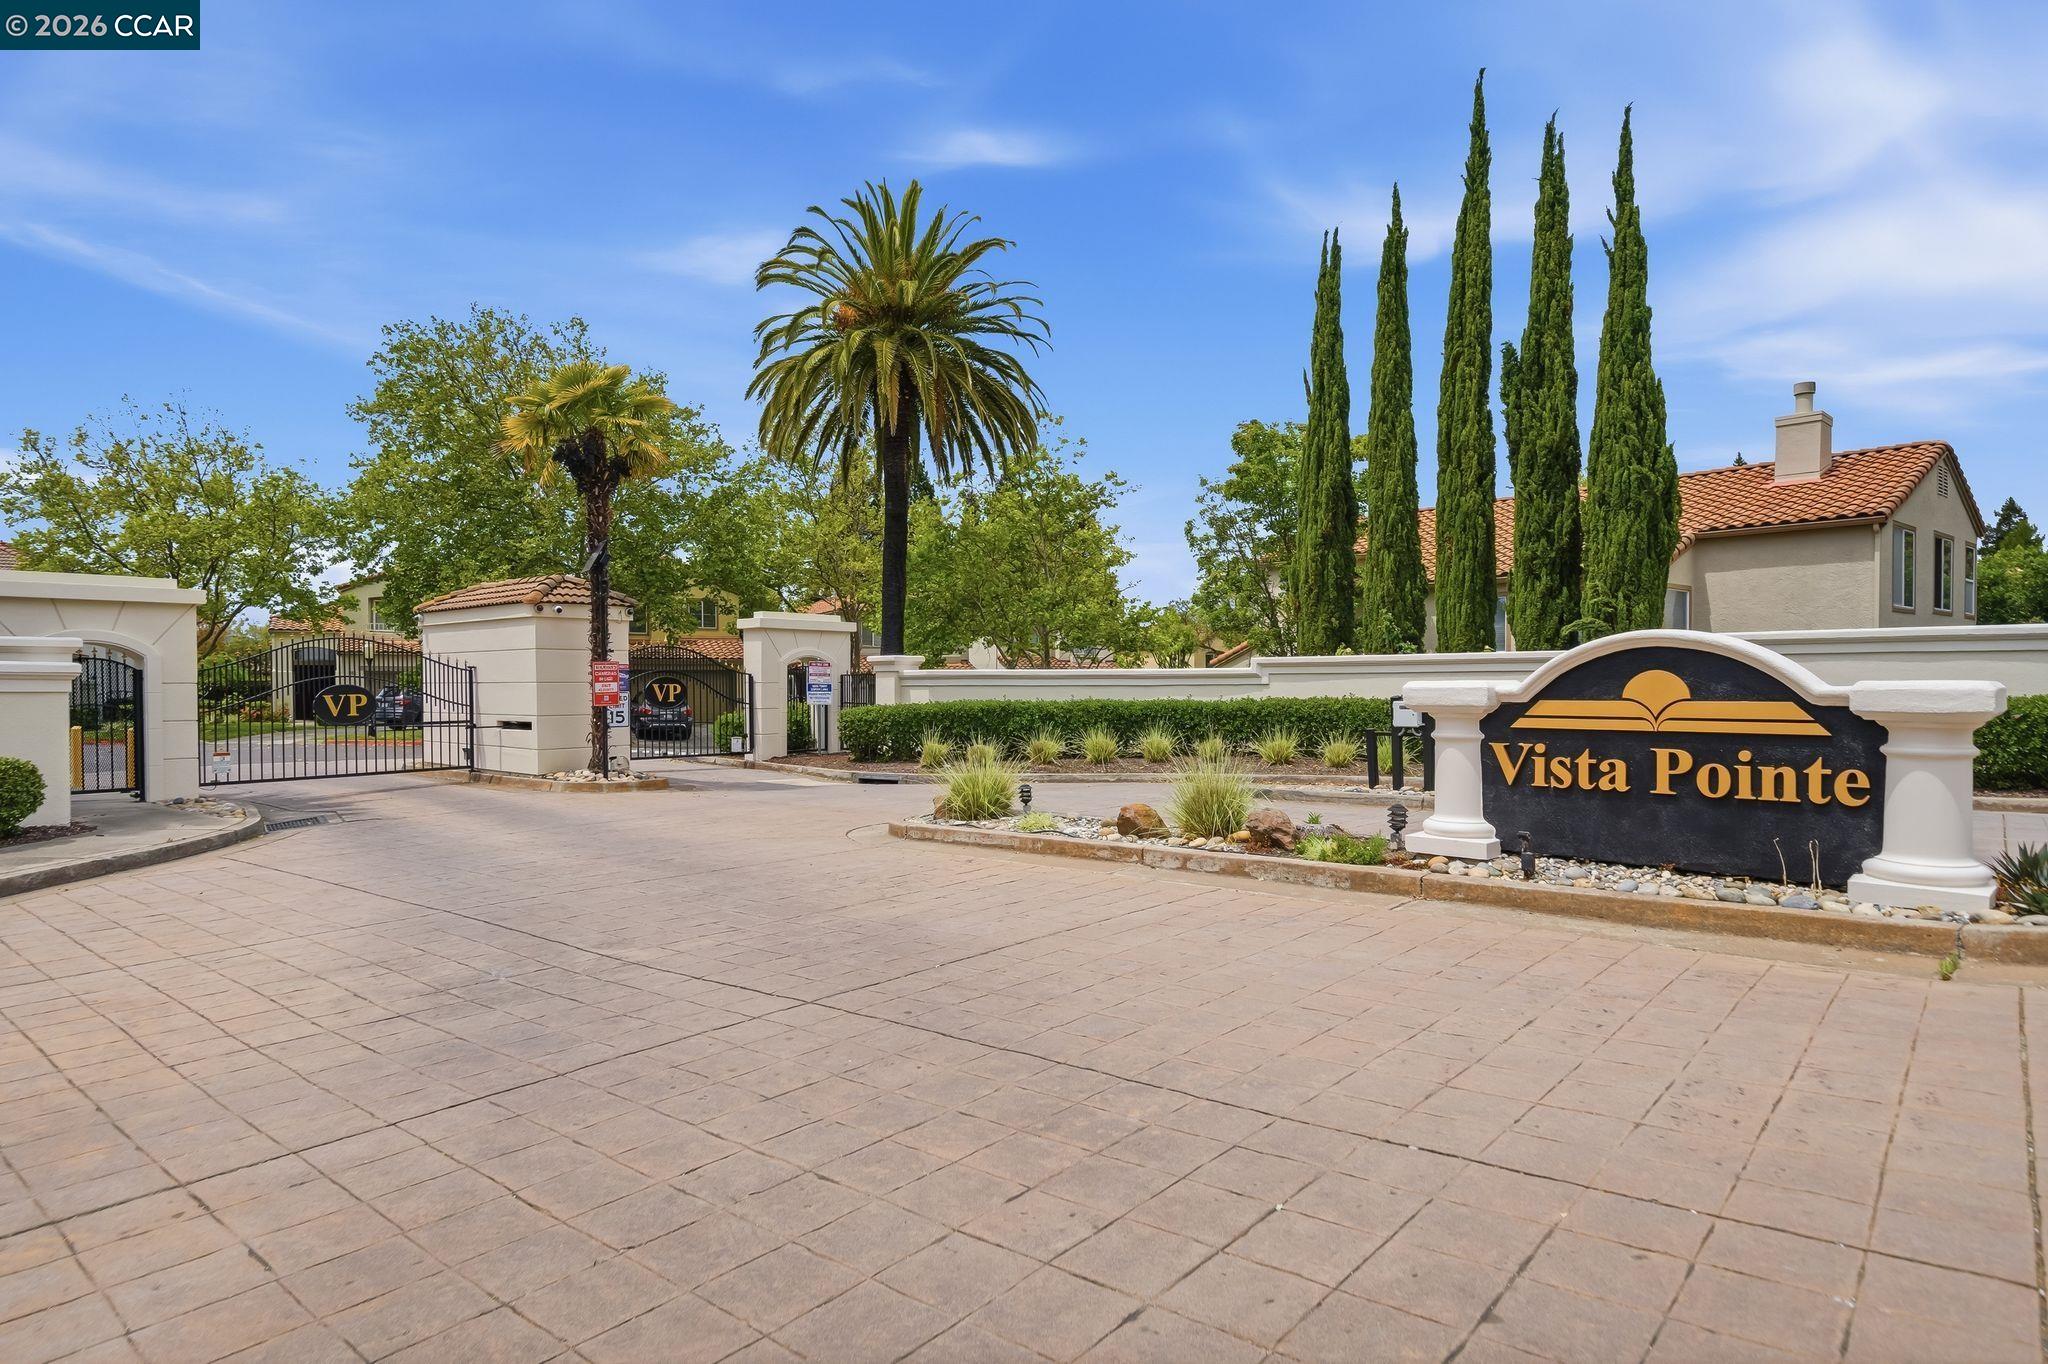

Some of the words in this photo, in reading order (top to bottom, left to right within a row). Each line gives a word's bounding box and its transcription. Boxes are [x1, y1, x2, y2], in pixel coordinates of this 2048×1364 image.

[652, 683, 682, 702] VP
[322, 693, 368, 718] VP
[608, 710, 626, 724] 15
[1488, 741, 1632, 793] Vista
[1649, 747, 1871, 808] Pointe
